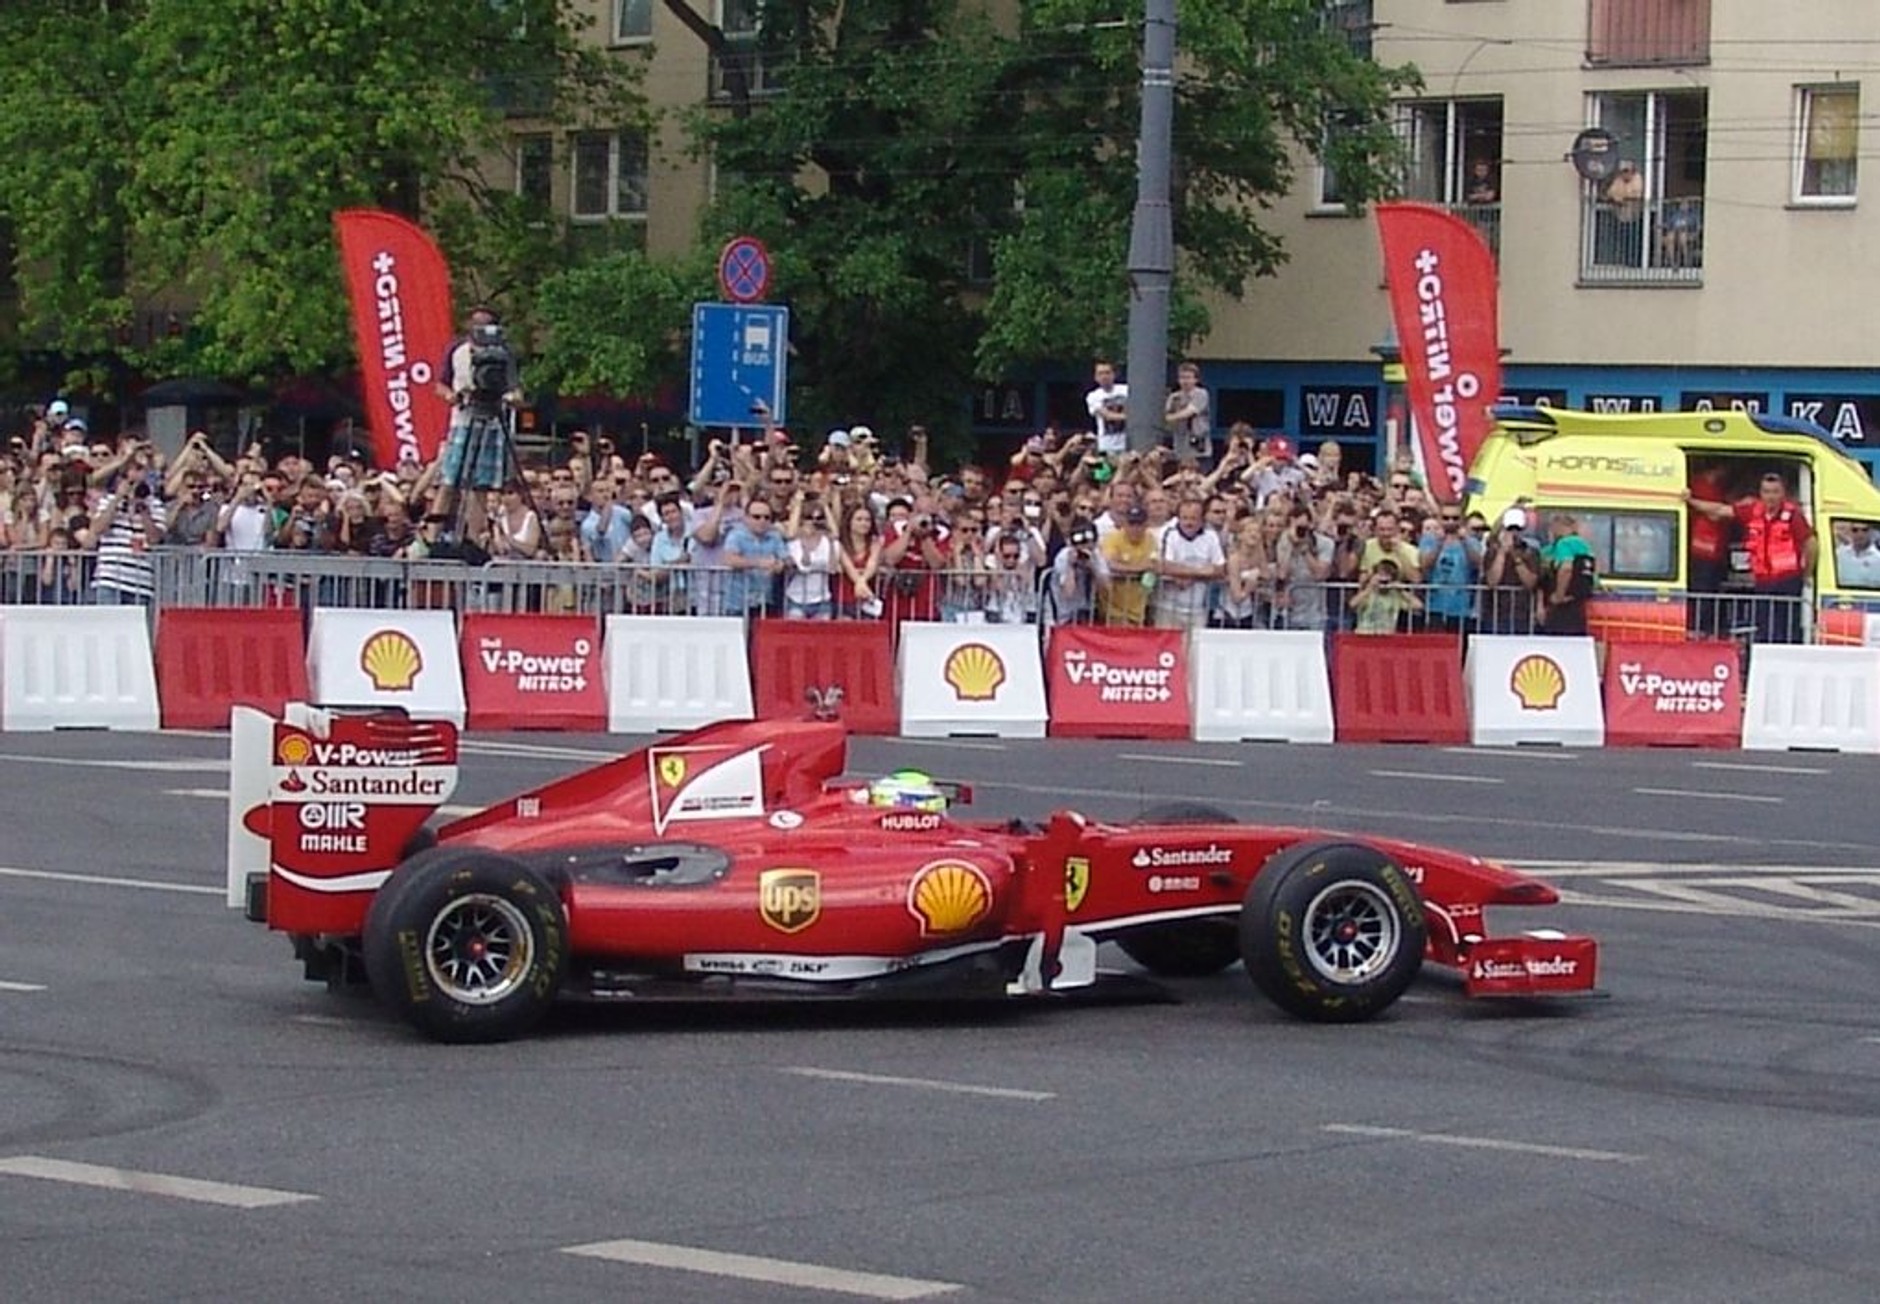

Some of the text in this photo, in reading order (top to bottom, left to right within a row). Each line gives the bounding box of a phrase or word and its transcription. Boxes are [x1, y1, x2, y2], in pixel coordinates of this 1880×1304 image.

[742, 352, 771, 366] BUS
[1306, 393, 1370, 427] WA
[481, 651, 586, 674] V-Power
[1065, 662, 1170, 685] V-Power
[1620, 674, 1725, 696] V-Power
[311, 769, 446, 795] Santander
[881, 816, 941, 830] HUBLOT
[301, 834, 367, 852] MAHLE
[1151, 844, 1233, 866] Santander
[765, 885, 816, 923] ups
